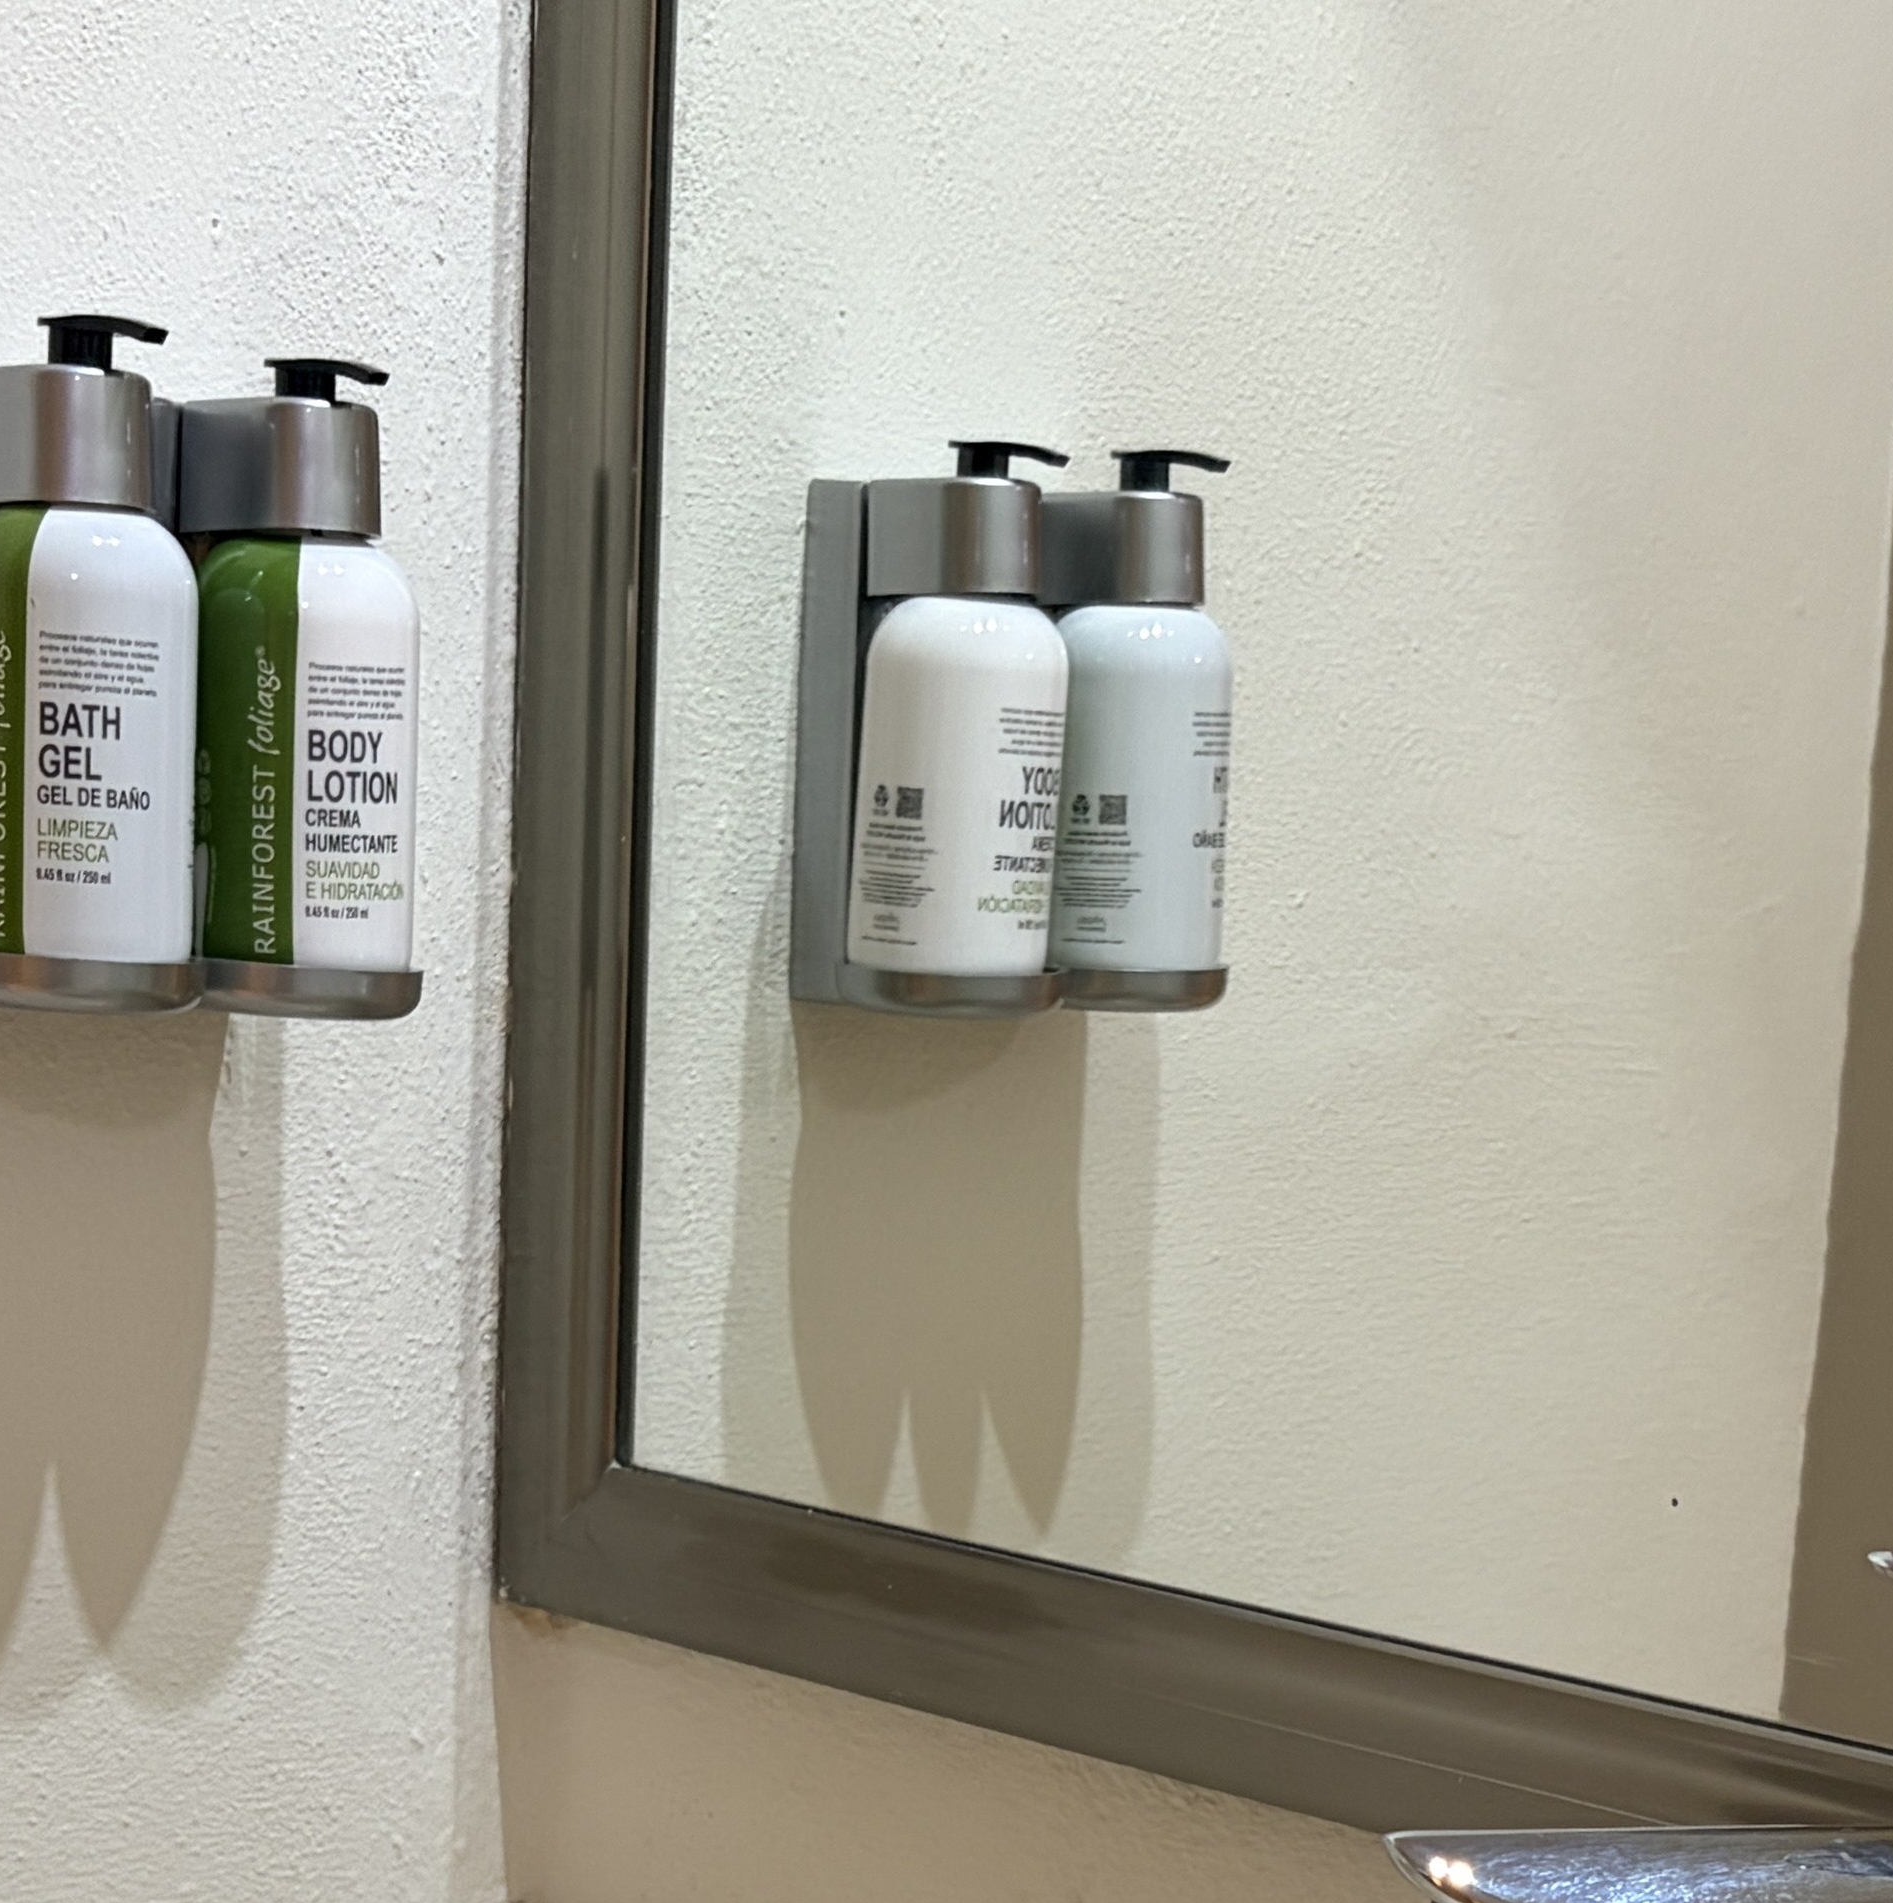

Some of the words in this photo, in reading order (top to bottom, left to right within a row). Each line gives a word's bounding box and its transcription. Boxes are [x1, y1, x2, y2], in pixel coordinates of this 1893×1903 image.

[39, 701, 121, 740] BATH
[308, 729, 383, 764] BODY
[38, 744, 102, 781] GEL
[37, 785, 73, 806] GEL
[78, 787, 101, 807] DE
[106, 787, 150, 811] BAÑO
[308, 770, 398, 804] LOTION
[37, 818, 118, 841] LIMPIEZA
[305, 808, 361, 828] CREMA
[36, 840, 109, 863] FRESCA
[305, 833, 398, 853] HUMECTANTE
[252, 765, 276, 954] RAINFOREST
[305, 860, 380, 880] SUAVIDAD
[306, 881, 316, 900] E
[321, 879, 404, 901] HIDRATACIÓN
